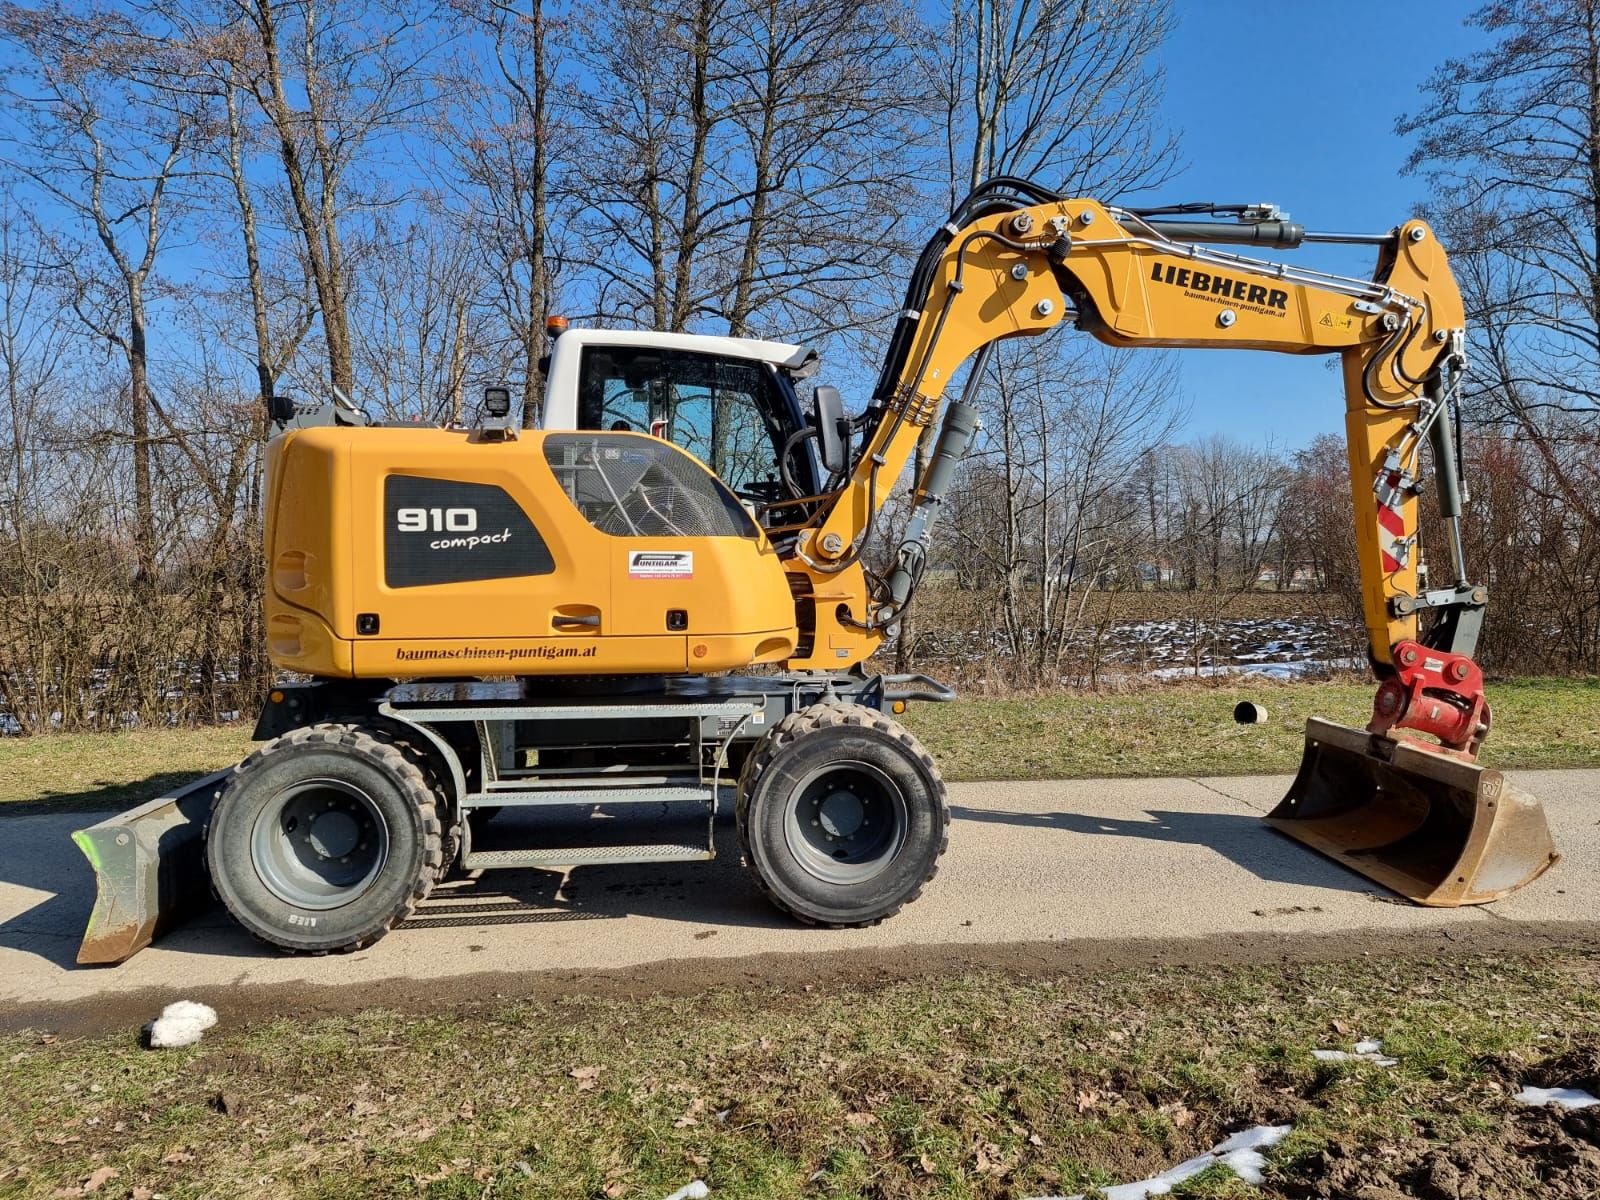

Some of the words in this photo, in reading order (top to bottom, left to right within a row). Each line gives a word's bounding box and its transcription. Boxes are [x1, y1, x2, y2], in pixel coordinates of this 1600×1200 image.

[1151, 262, 1288, 310] LIEBHERR
[1184, 290, 1286, 318] baumaschinen-puntigam.at
[397, 508, 478, 532] 910
[430, 528, 512, 550] compact
[396, 646, 597, 661] baumaschinen-puntigam.at
